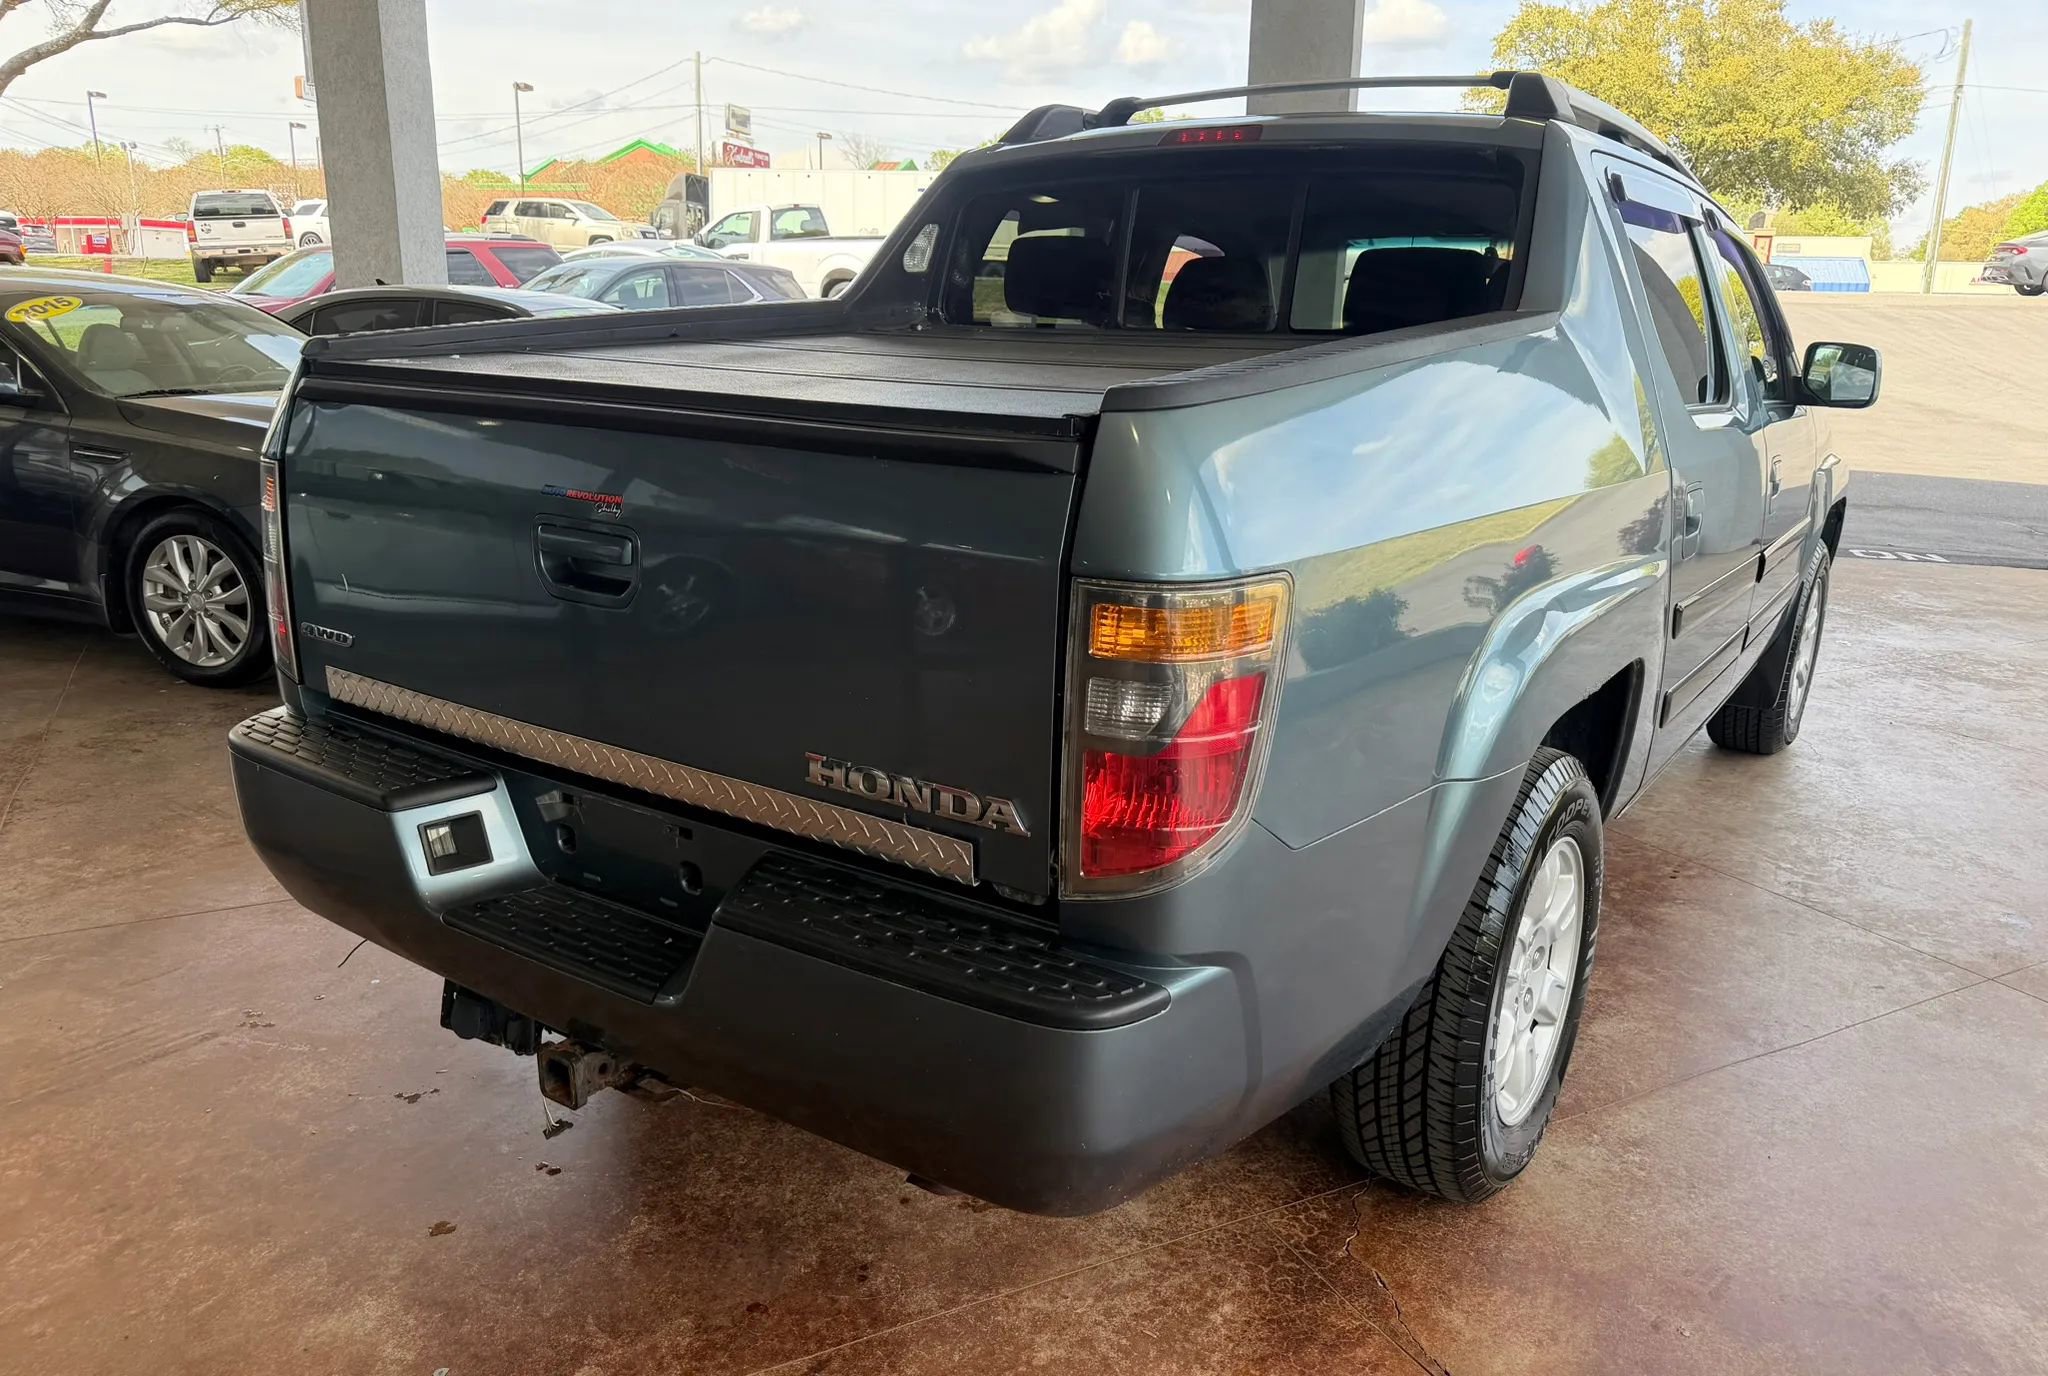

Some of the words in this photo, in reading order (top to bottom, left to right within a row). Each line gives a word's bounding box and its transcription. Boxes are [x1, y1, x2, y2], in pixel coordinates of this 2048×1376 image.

[15, 297, 73, 319] 2015
[566, 489, 624, 503] REVOLUTION
[302, 623, 350, 646] 4WD
[805, 751, 1032, 838] HONDA
